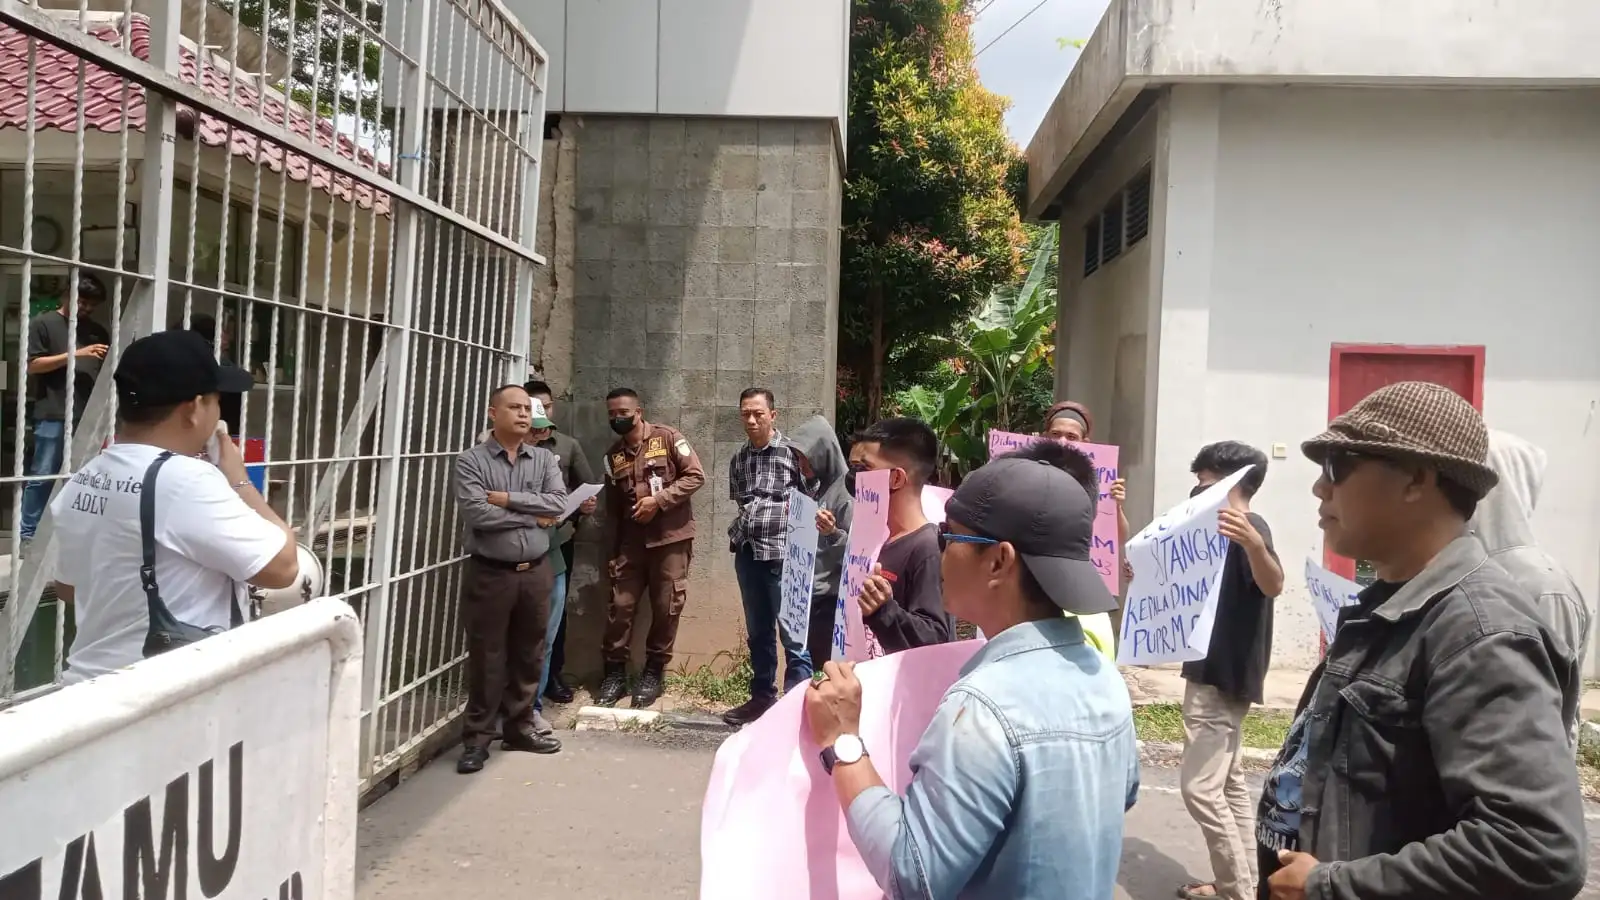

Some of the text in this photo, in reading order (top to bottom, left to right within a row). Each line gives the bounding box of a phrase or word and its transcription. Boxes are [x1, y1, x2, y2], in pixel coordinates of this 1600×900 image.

[101, 473, 111, 491] la
[116, 476, 143, 494] vie
[71, 491, 108, 516] ADLV
[1124, 594, 1169, 640] KEPALA
